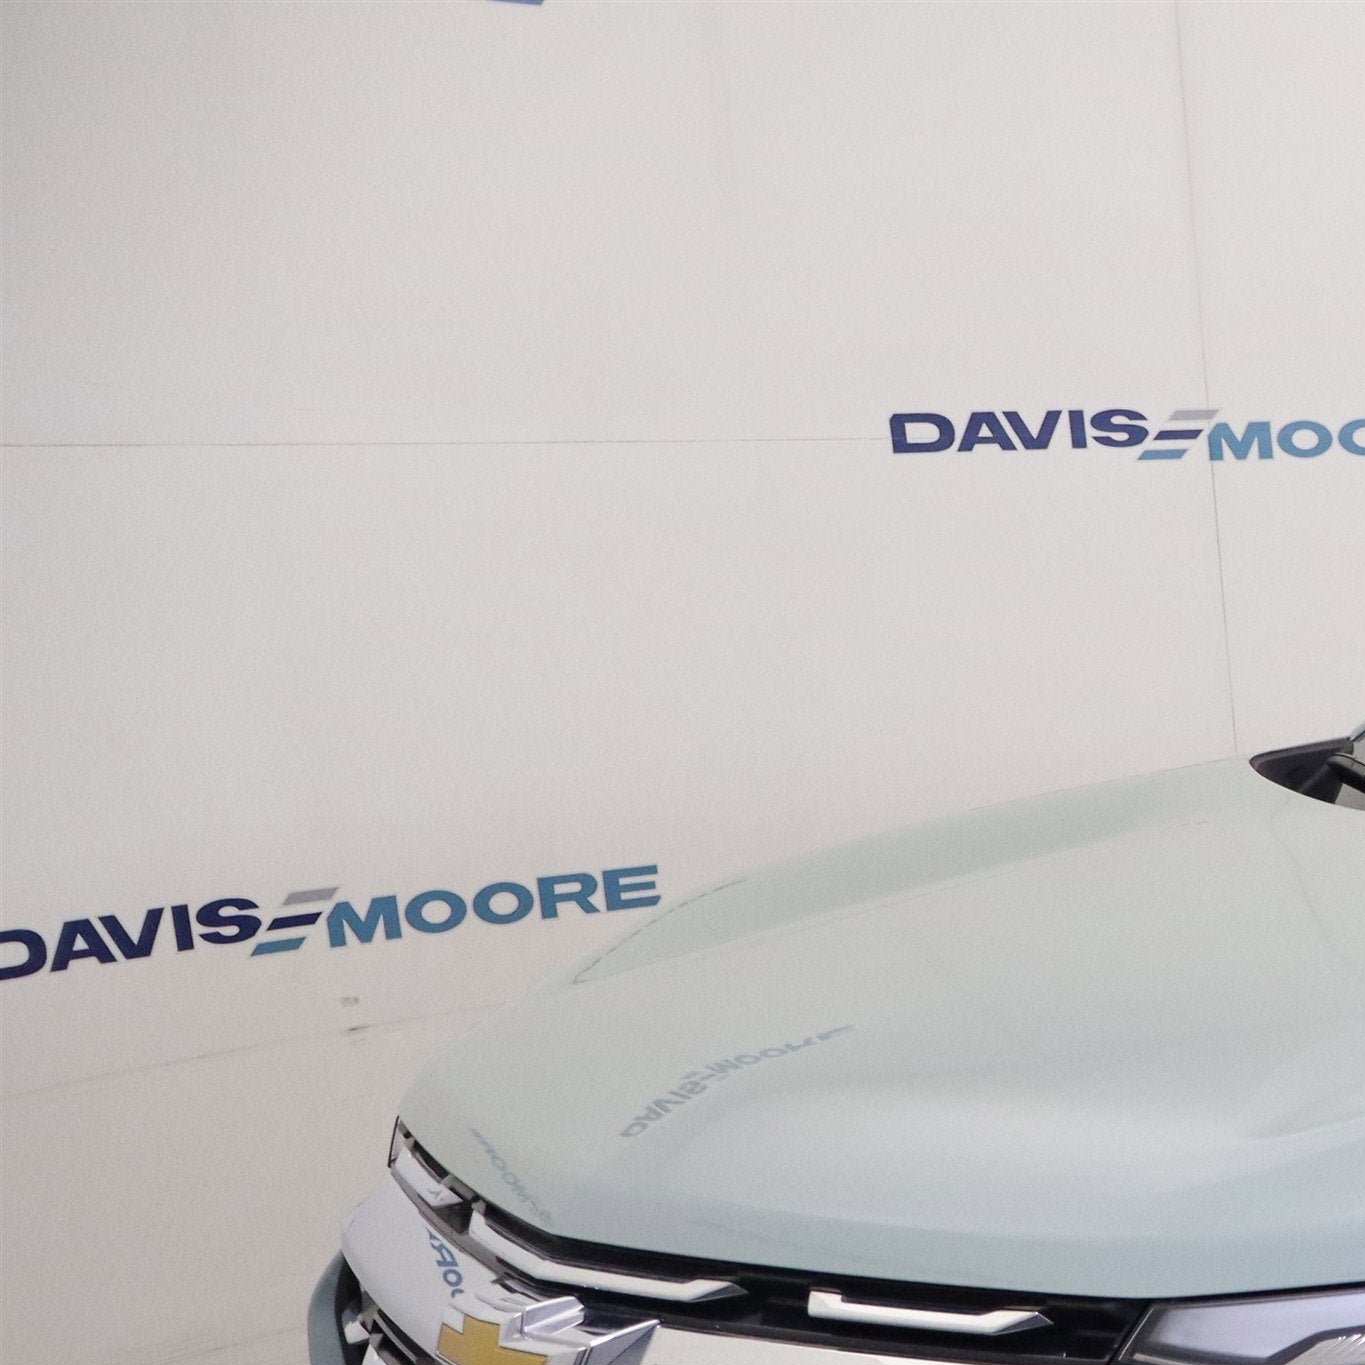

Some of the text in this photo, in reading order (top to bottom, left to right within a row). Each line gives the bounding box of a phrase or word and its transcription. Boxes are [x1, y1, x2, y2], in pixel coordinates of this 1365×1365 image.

[889, 408, 1151, 455] DAVIS
[0, 864, 662, 981] DAVIS MOORE
